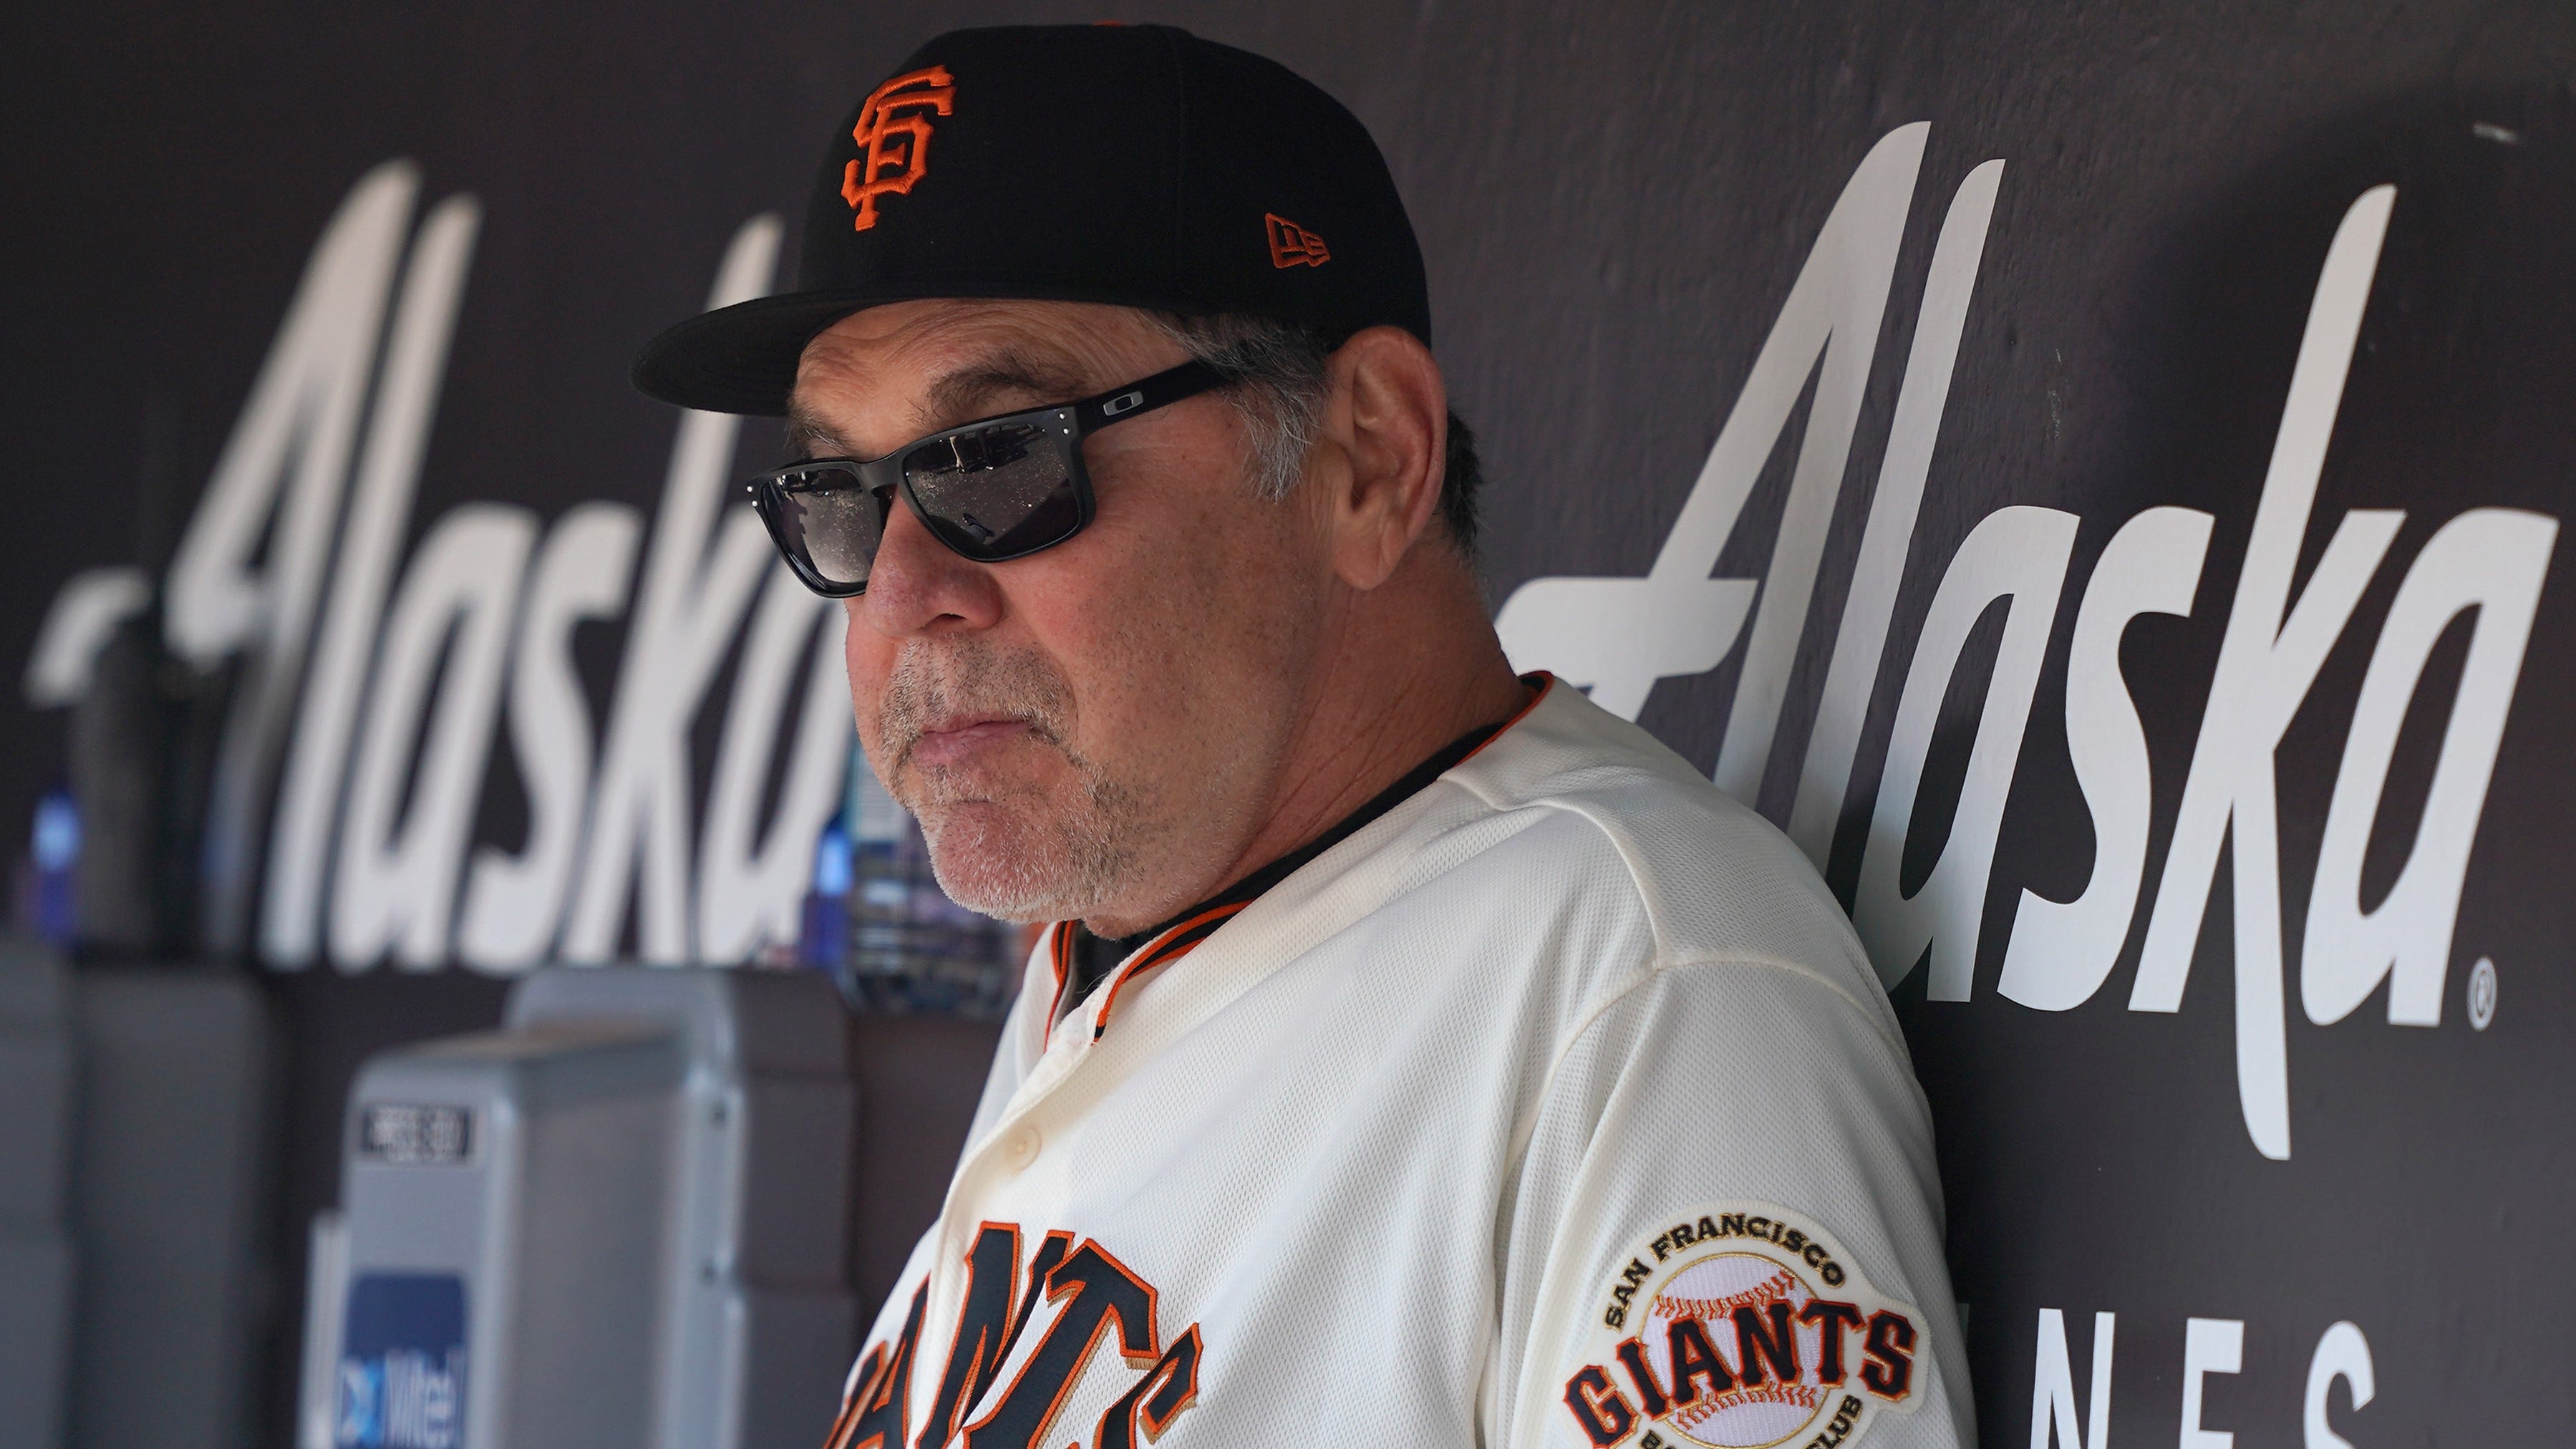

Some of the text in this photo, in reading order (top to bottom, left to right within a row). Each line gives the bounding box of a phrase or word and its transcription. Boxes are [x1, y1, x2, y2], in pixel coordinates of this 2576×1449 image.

[24, 159, 856, 972] Alaska
[1493, 120, 2560, 1161] Alaska
[822, 1220, 1204, 1449] ANTS
[1604, 1211, 1846, 1333] SAN FRANCISCO
[1562, 1297, 1919, 1449] GIANTS
[1802, 1393, 1864, 1449] LUB
